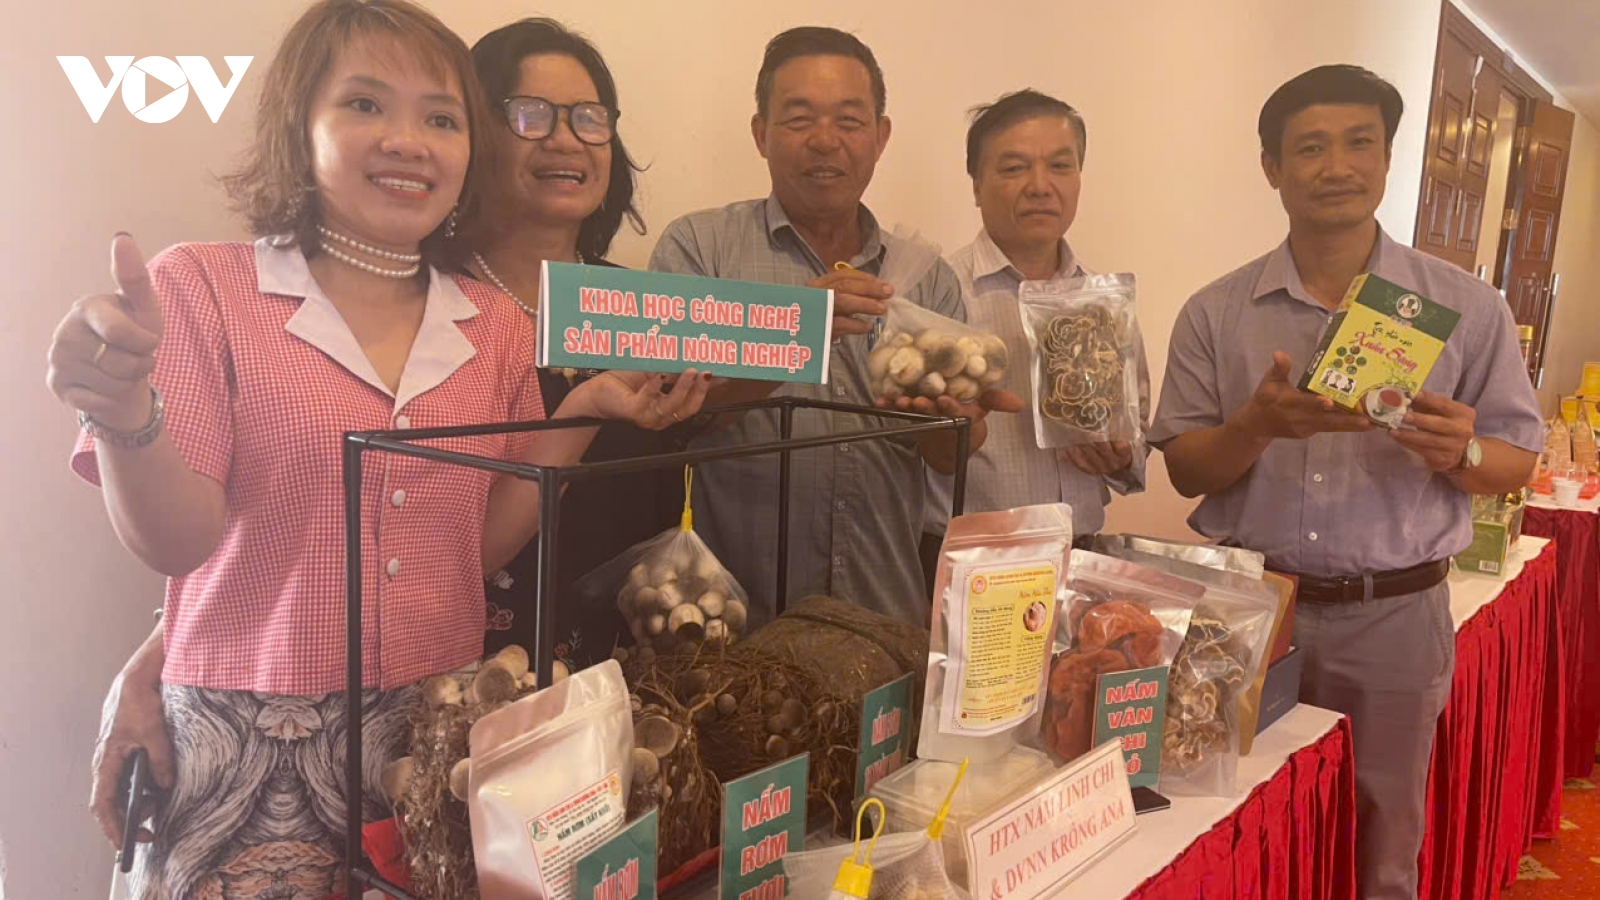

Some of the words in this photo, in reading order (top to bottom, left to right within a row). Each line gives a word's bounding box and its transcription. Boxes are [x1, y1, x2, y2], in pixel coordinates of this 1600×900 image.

[580, 286, 638, 317] KHOA
[642, 293, 684, 325] HỌC
[690, 295, 743, 327] CÔNG
[749, 303, 801, 336] NGHỆ
[563, 320, 611, 356] SẢN
[616, 324, 678, 360] PHẨM
[682, 333, 737, 365] NÔNG
[741, 341, 811, 373] NGHIỆP
[1106, 679, 1159, 704] NẤM
[1108, 706, 1153, 729] VÂN
[1121, 732, 1146, 751] HI
[1125, 753, 1141, 775] Ỏ
[742, 783, 791, 832] NẤM
[988, 818, 1021, 857] HTX
[1058, 774, 1090, 814] LINH
[1093, 760, 1115, 790] CHI
[741, 830, 788, 876] RƠM
[1005, 845, 1049, 893] DVNN
[1050, 813, 1097, 864] KRÔNG
[1100, 797, 1125, 831] ANA
